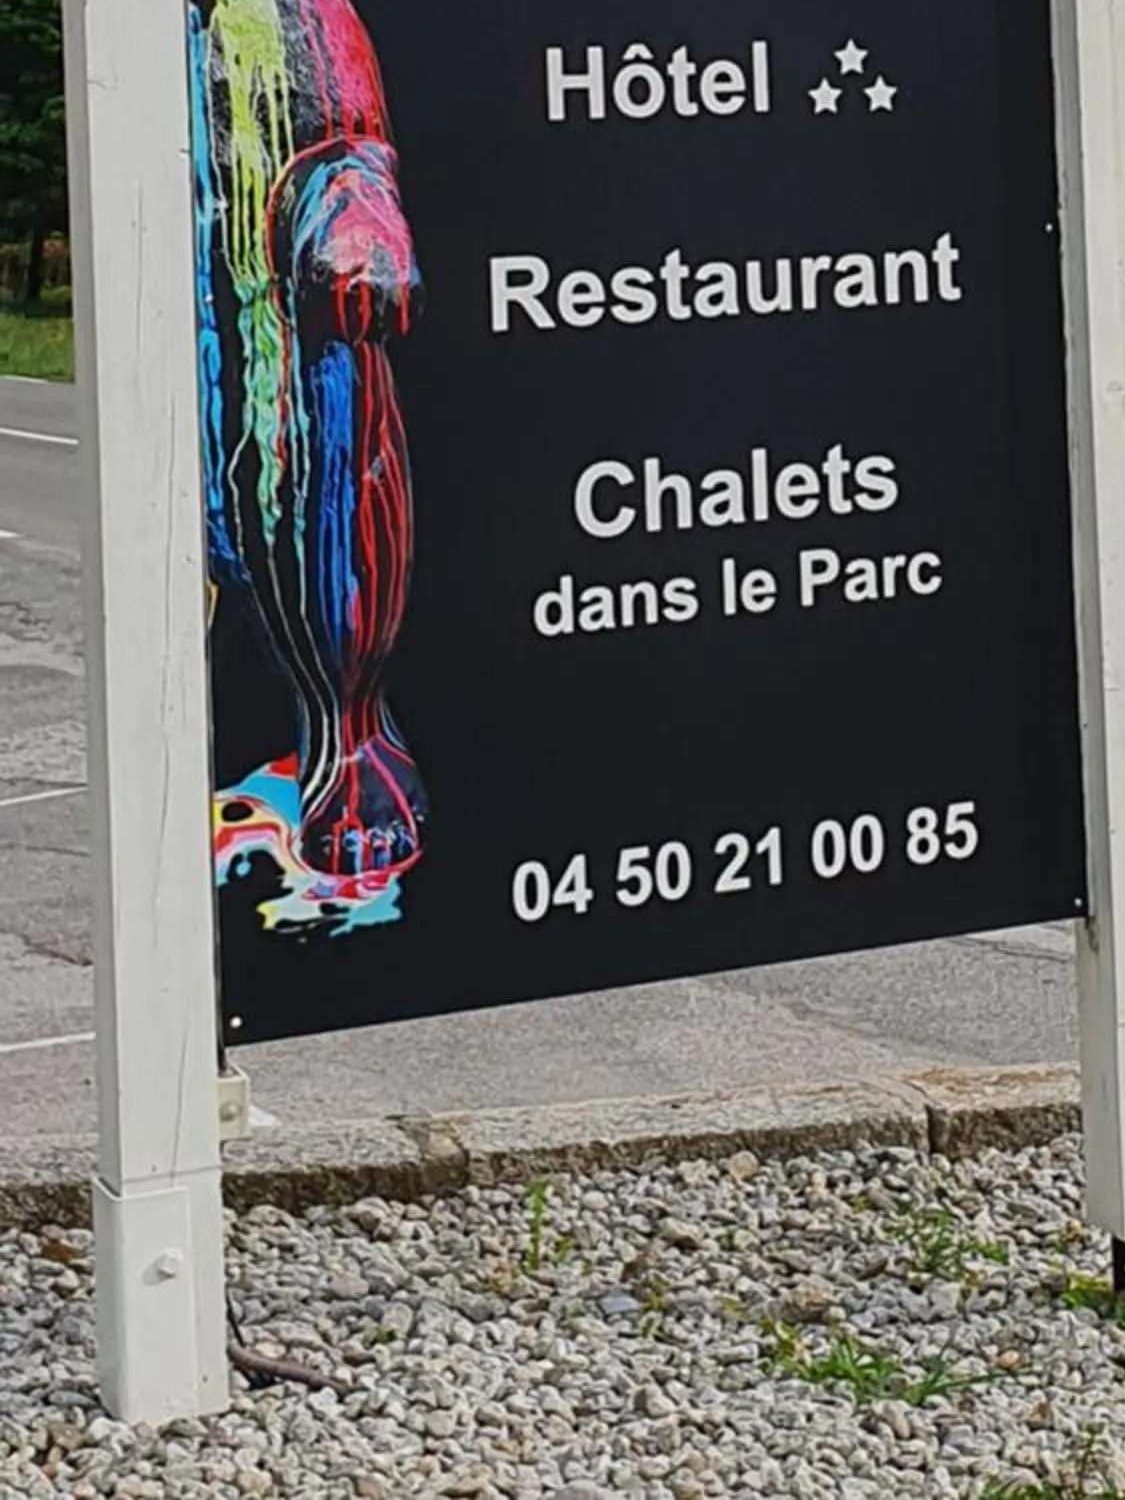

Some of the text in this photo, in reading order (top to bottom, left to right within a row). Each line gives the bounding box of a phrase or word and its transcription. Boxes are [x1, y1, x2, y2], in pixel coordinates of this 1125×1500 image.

[546, 41, 769, 121] Hôtel
[490, 231, 962, 332] Restaurant
[575, 443, 898, 538] Chalets
[534, 548, 942, 636] dans le Parc
[513, 801, 978, 921] 04 50 21 00 85
